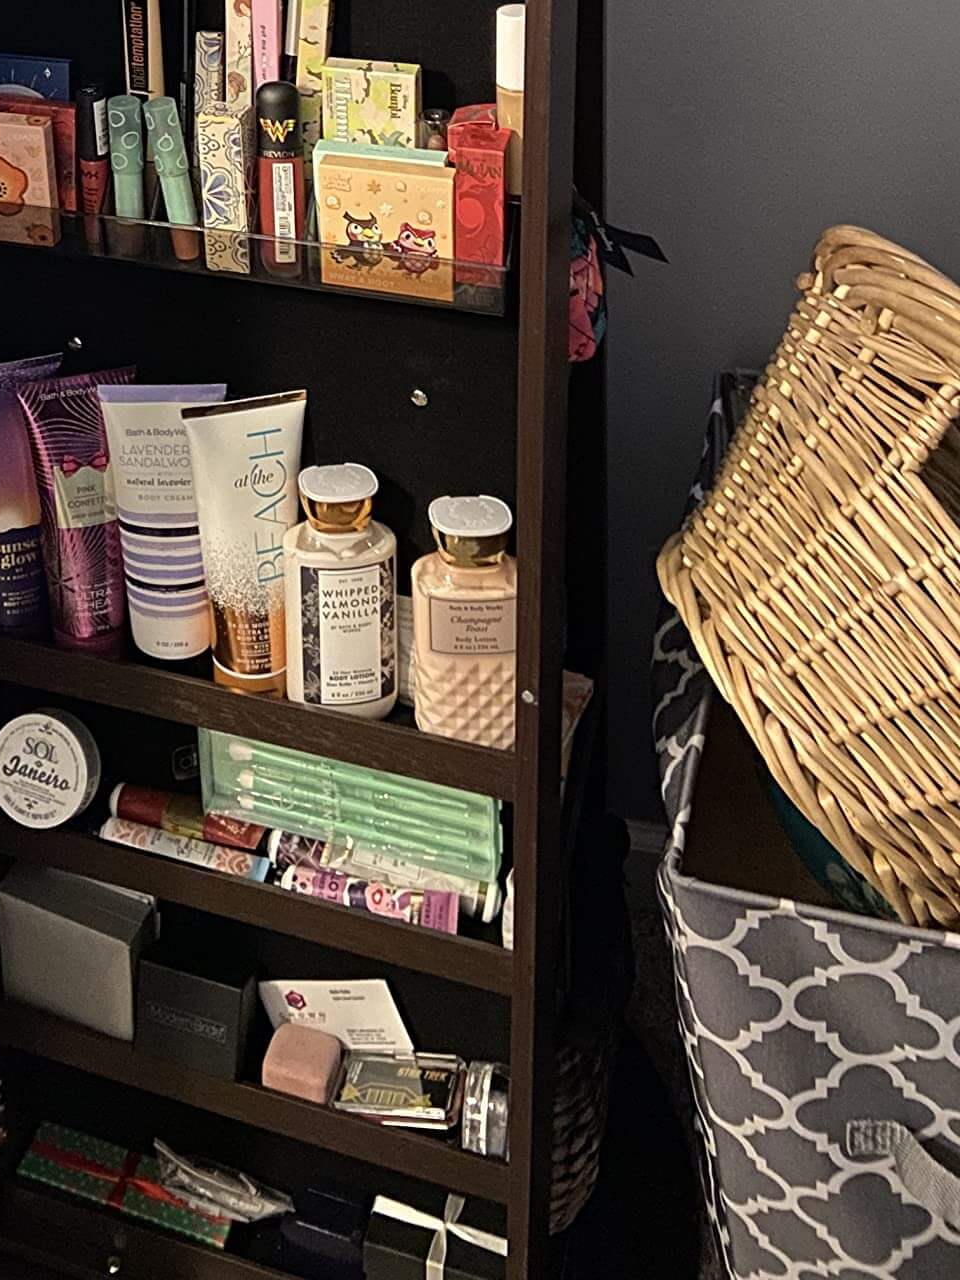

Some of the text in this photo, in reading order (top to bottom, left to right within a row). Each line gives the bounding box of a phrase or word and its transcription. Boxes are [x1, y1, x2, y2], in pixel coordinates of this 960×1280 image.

[263, 150, 295, 158] REVLON
[121, 444, 191, 456] LAVENDER
[234, 469, 274, 489] at the
[321, 584, 378, 599] WHIPPED
[321, 595, 379, 610] ALMOND
[322, 606, 378, 620] VANILLA
[22, 736, 59, 764] SOL
[2, 755, 71, 791] Janeiro
[423, 1070, 448, 1081] TREK
